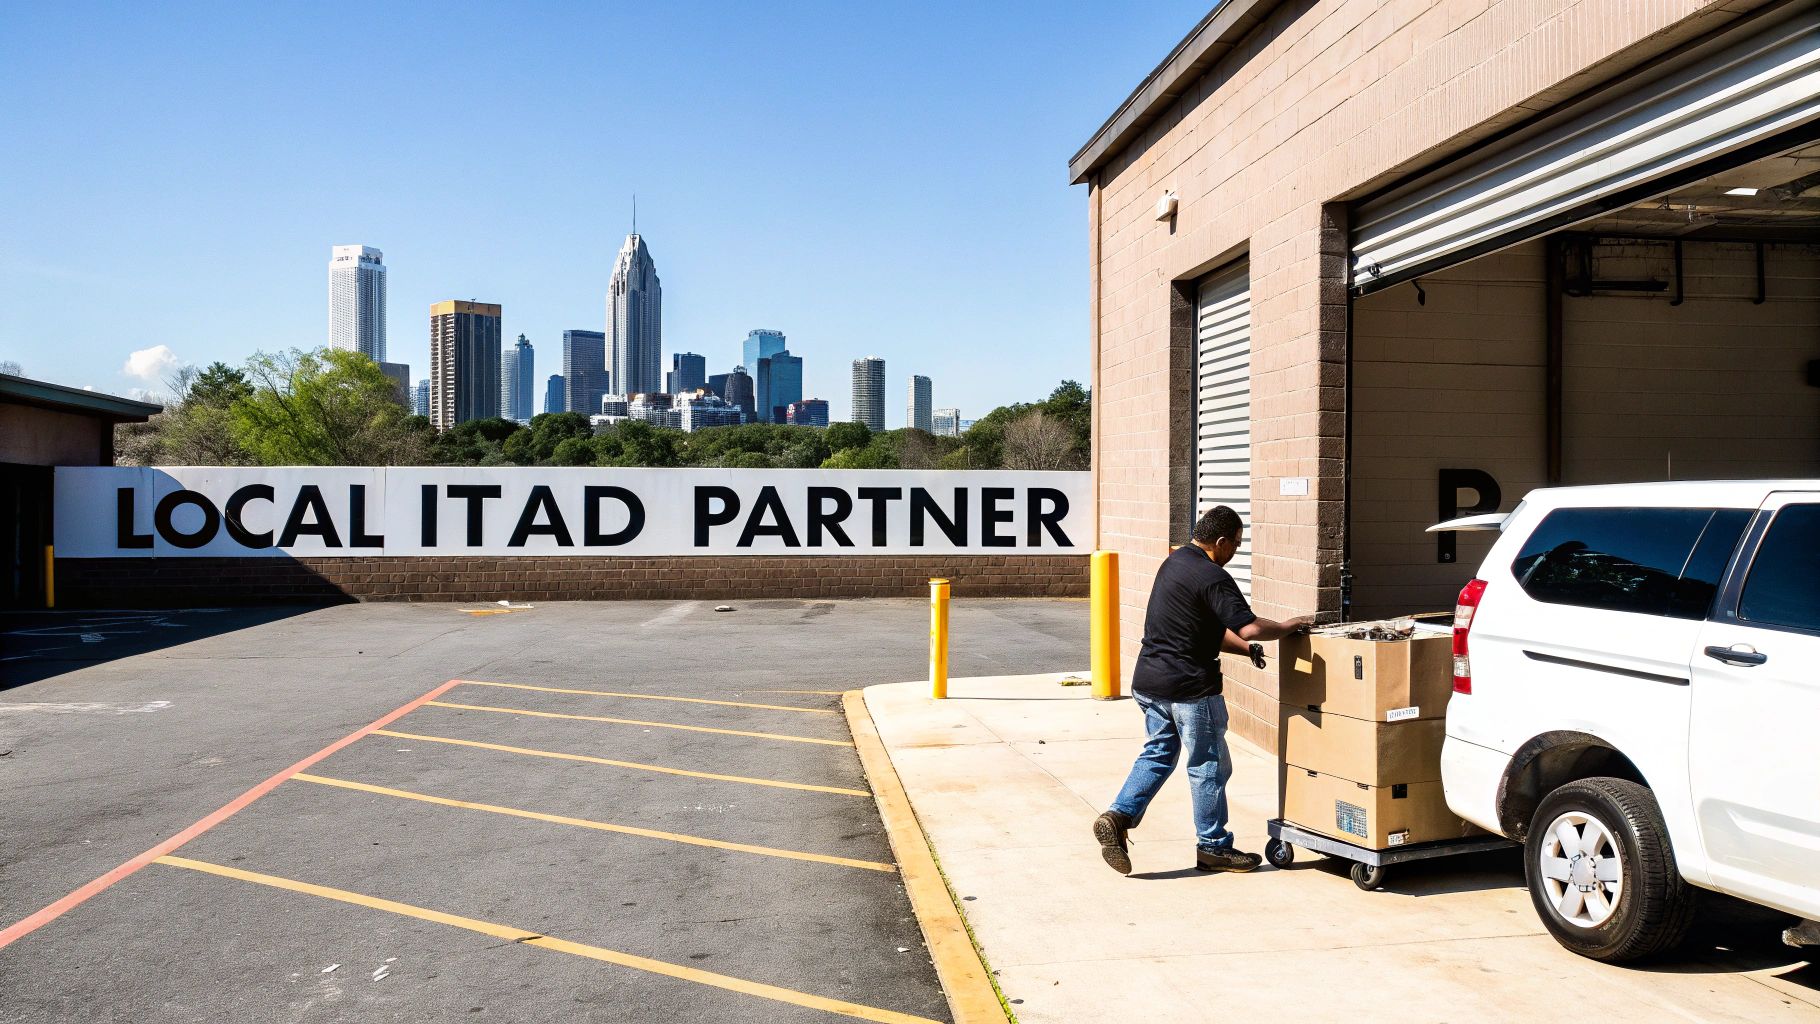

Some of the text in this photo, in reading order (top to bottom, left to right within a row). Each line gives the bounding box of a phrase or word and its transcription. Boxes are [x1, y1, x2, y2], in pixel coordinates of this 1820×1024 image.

[117, 483, 1075, 549] LOCAL ITAD PARTNER
